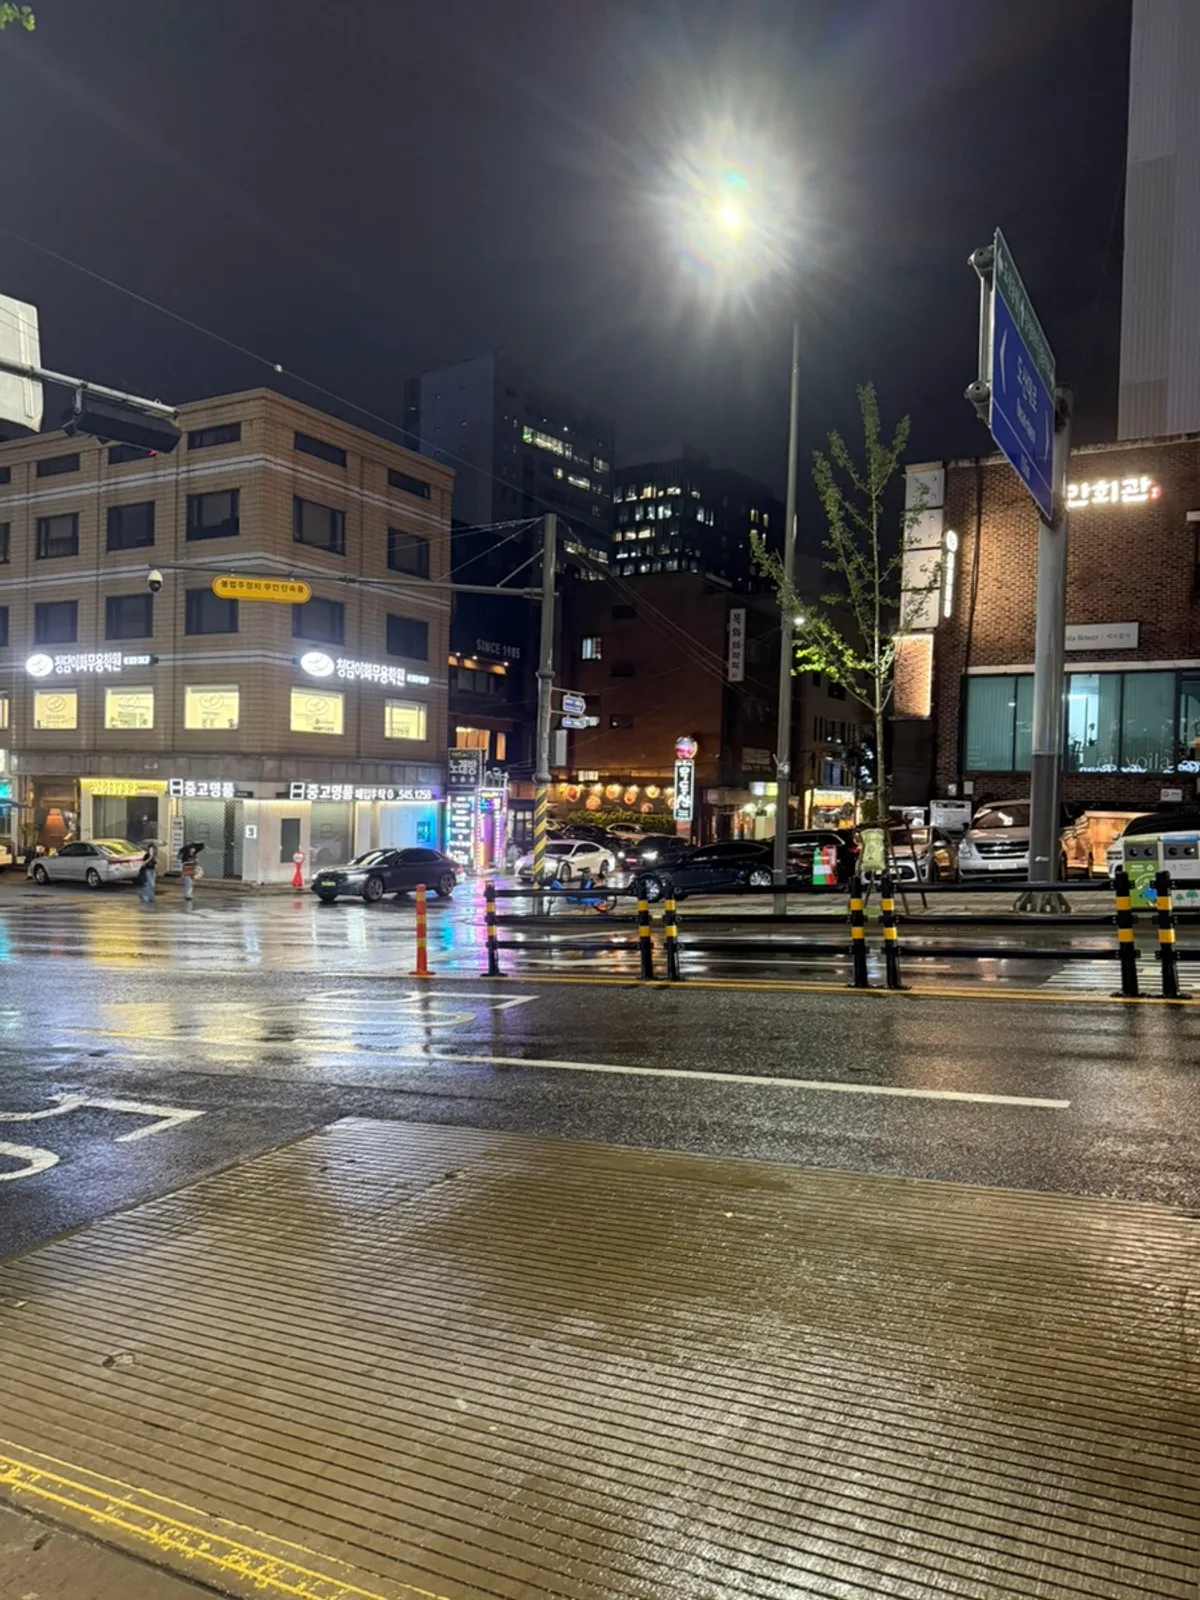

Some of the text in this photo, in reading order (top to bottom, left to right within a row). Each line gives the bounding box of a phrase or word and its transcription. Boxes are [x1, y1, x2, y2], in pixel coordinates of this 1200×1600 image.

[476, 638, 500, 655] SINCE
[184, 781, 235, 798] 중고명품
[306, 783, 354, 800] 중고명품
